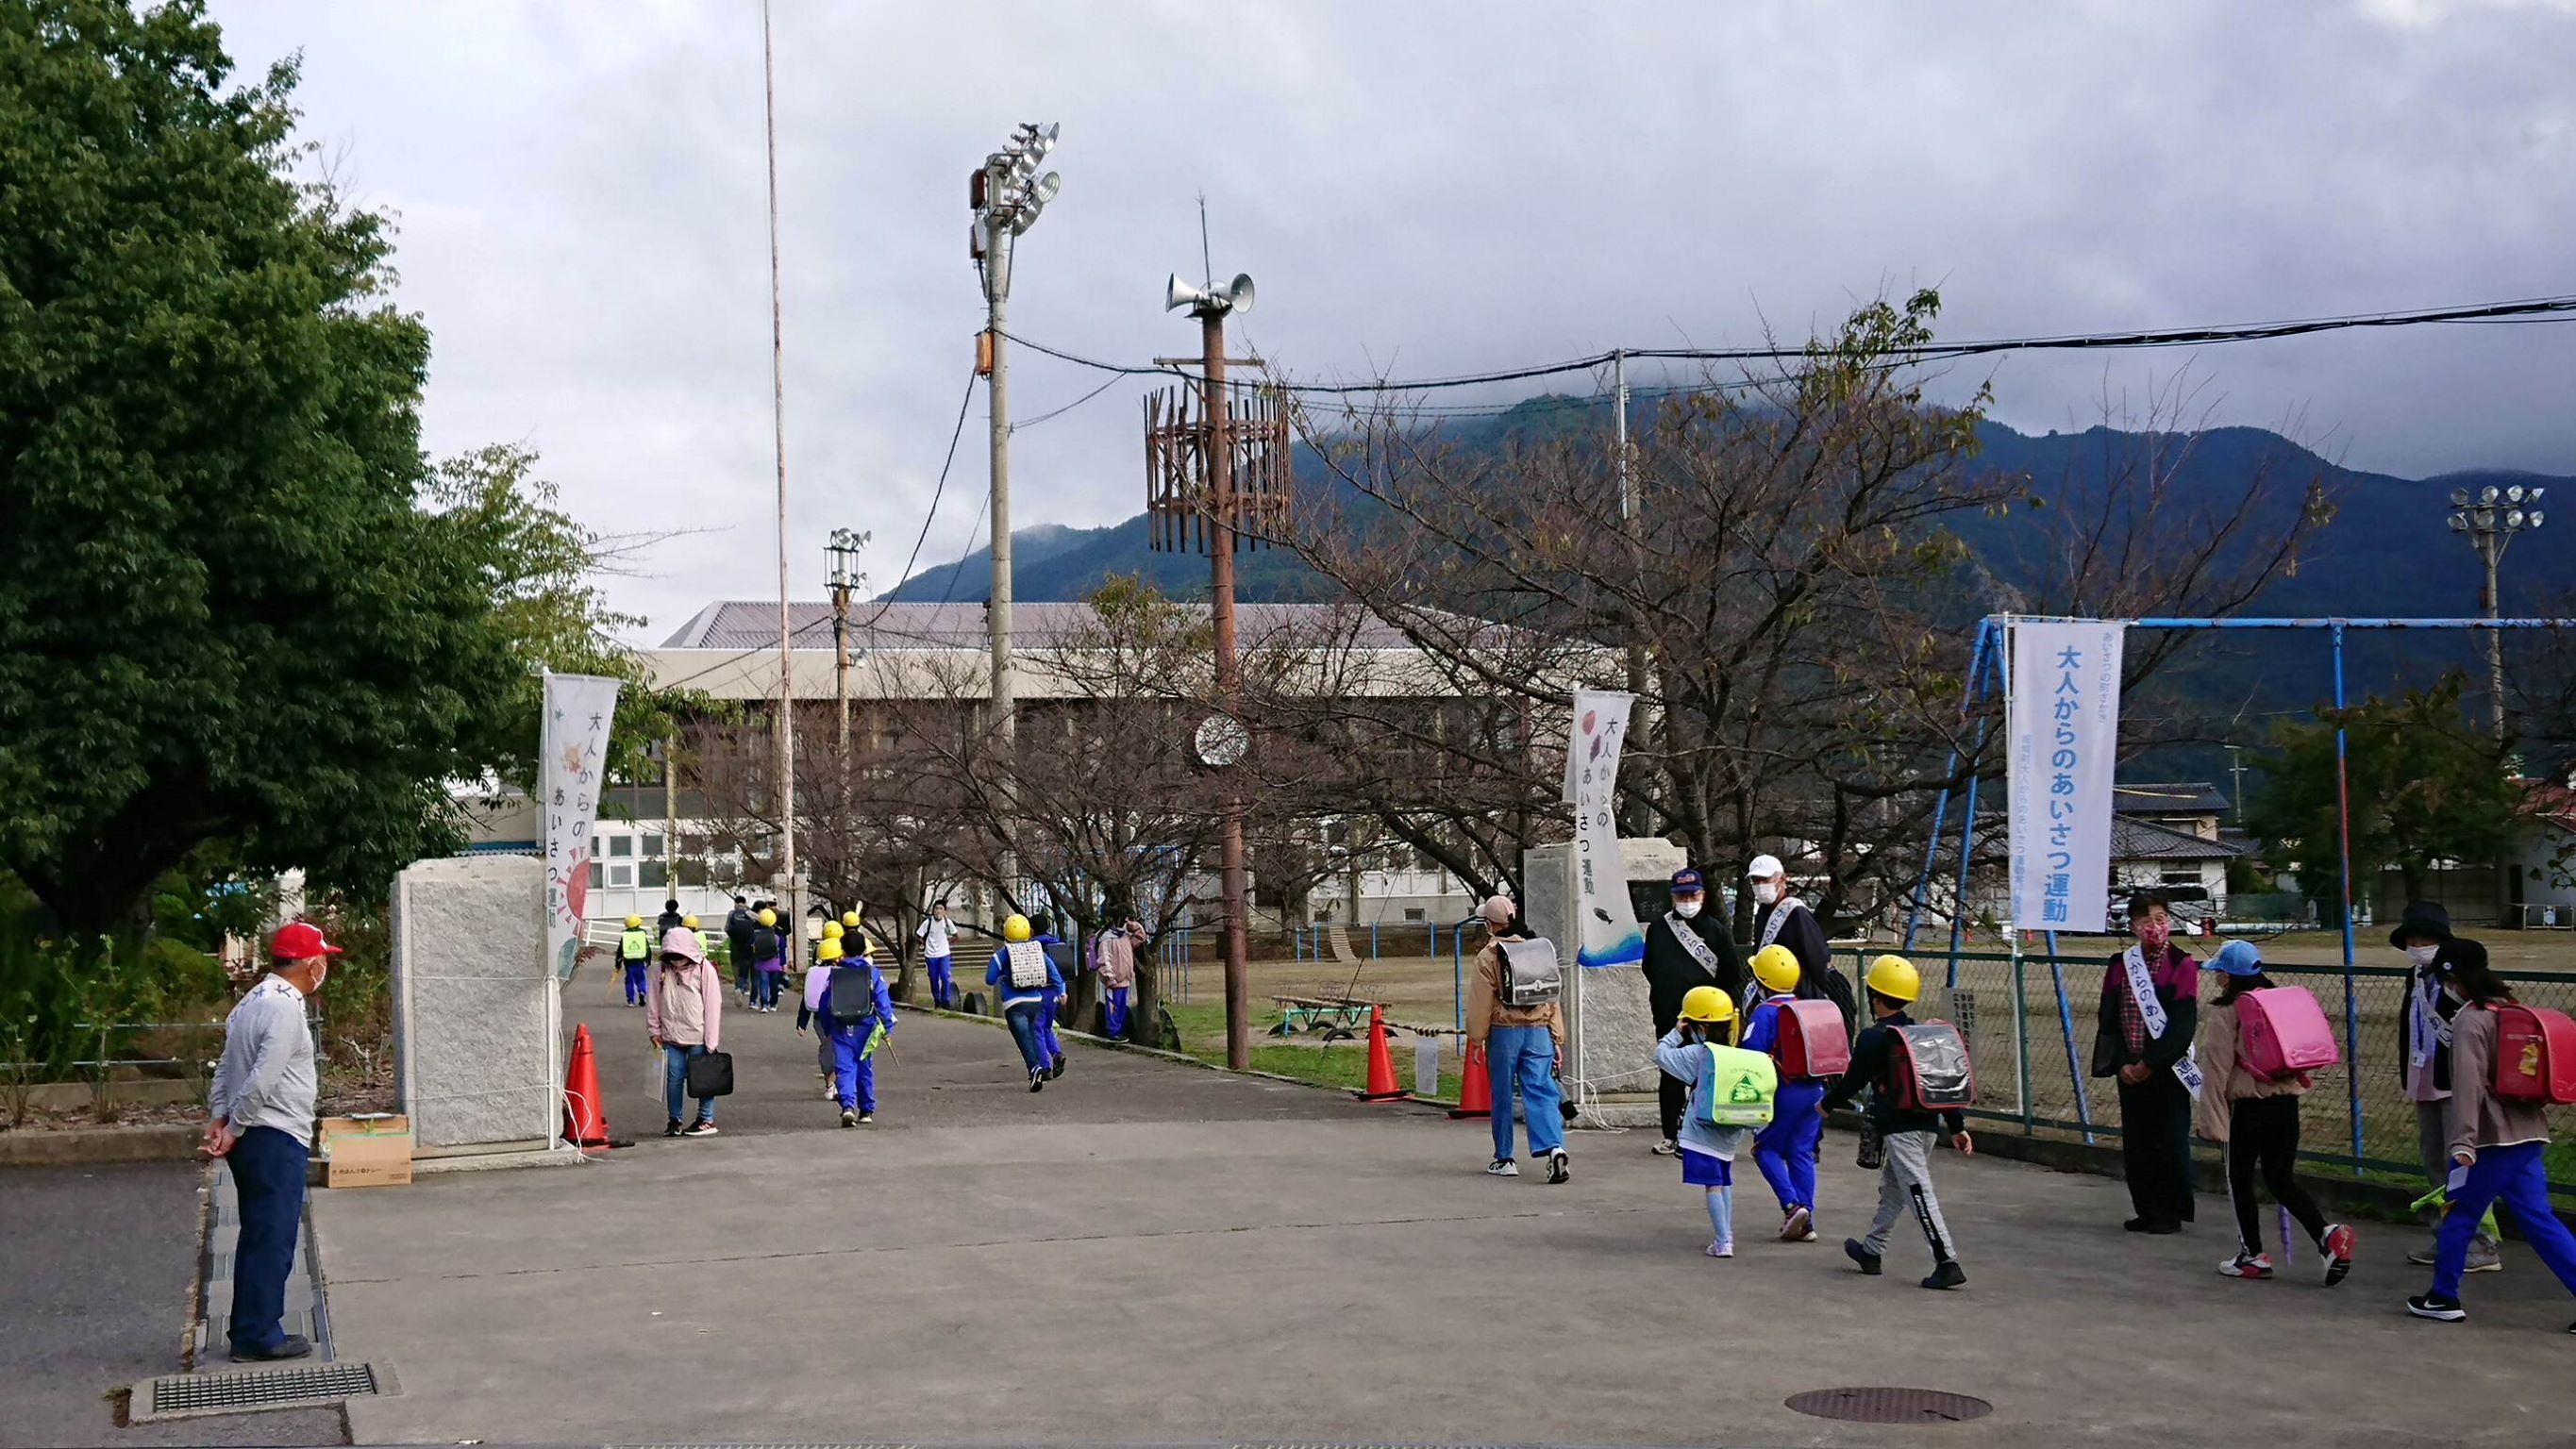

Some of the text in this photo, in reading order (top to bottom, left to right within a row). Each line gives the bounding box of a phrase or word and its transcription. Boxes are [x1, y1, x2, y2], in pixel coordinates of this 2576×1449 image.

[573, 712, 602, 838] 大人からの
[2042, 645, 2082, 923] 大人からのあいさつ運動
